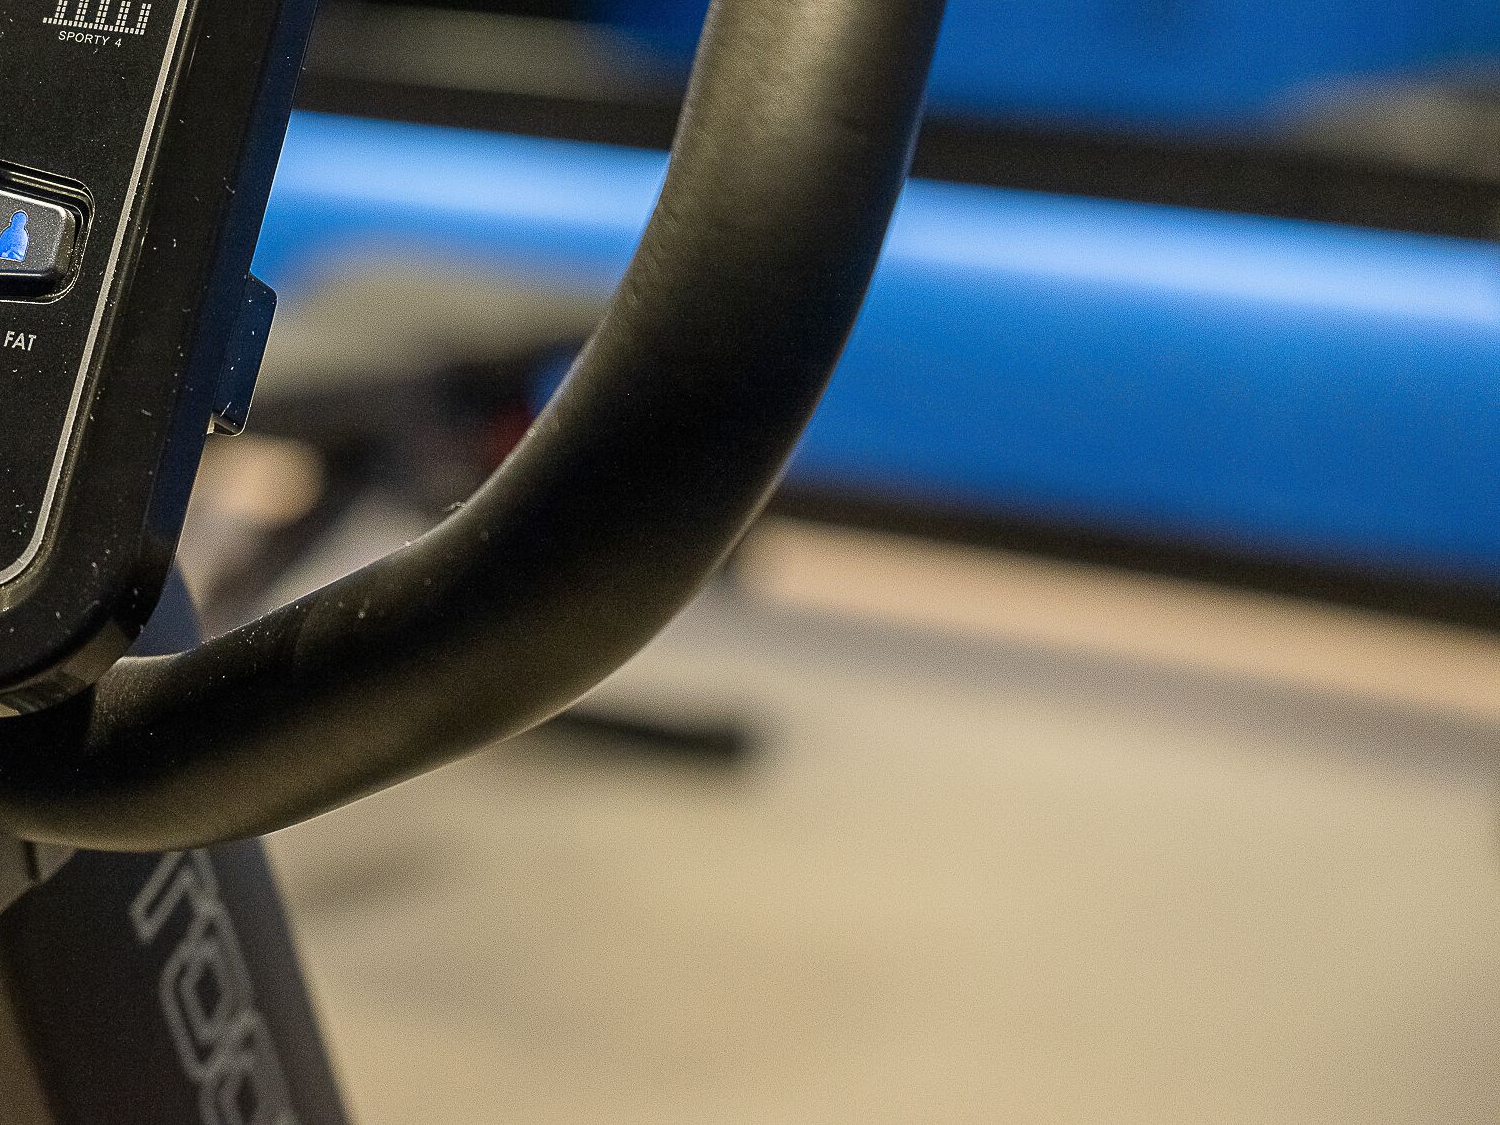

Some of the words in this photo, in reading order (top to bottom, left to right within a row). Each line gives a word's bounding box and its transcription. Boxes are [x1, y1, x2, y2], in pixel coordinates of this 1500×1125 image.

[58, 30, 110, 46] SPORTY
[114, 38, 123, 48] 4
[3, 330, 37, 352] FAT
